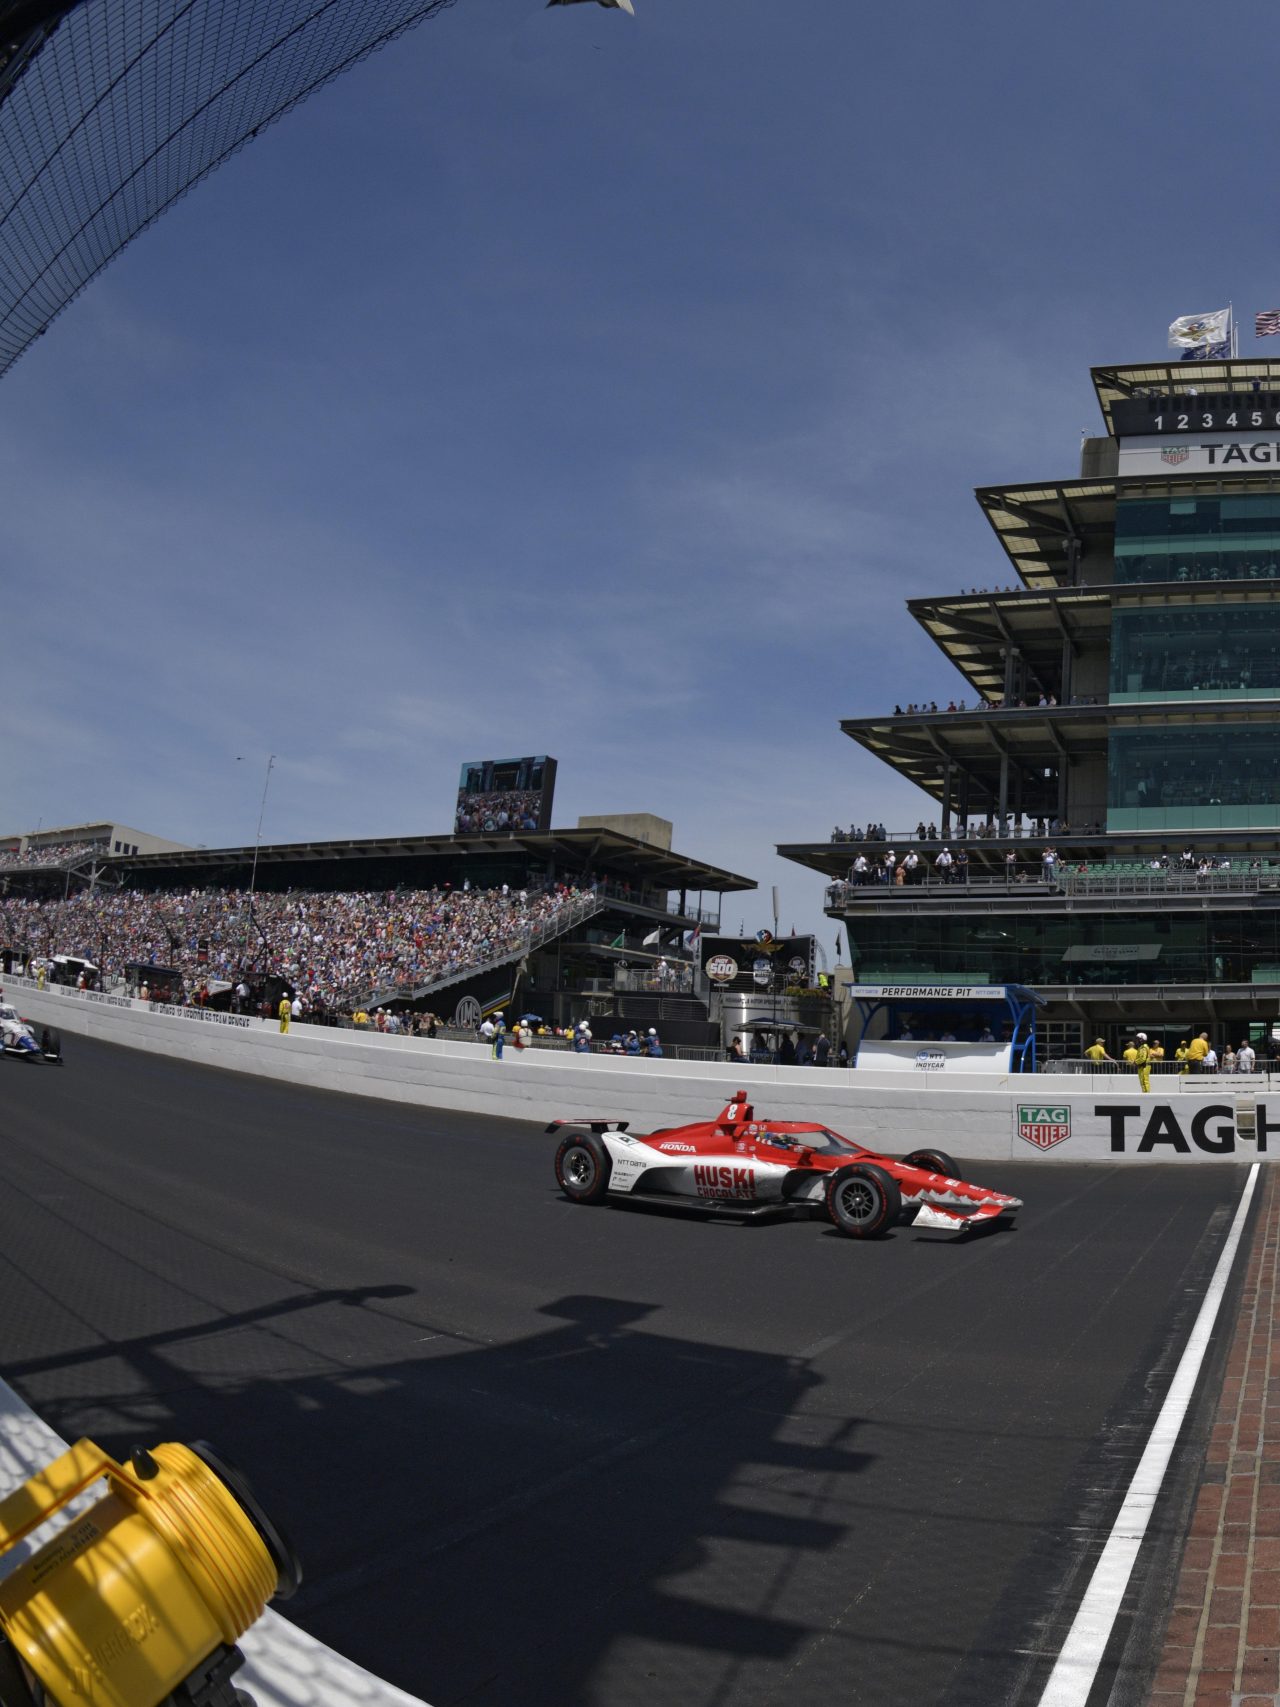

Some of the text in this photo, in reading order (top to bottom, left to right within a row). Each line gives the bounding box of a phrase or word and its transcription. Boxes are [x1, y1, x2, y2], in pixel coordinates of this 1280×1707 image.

[1154, 416, 1163, 430] 1
[1177, 415, 1189, 429] 2
[1202, 413, 1213, 428] 3
[1226, 412, 1238, 427] 4
[1251, 411, 1262, 426] 5
[710, 963, 734, 975] 500
[881, 987, 972, 997] PERFORMANCE PIT
[727, 1104, 738, 1120] 8
[1022, 1108, 1066, 1123] TAG
[1020, 1124, 1068, 1147] HEUER
[659, 1143, 697, 1153] HONDA
[694, 1165, 756, 1190] HUSKI
[697, 1187, 757, 1200] CHOCOLATE
